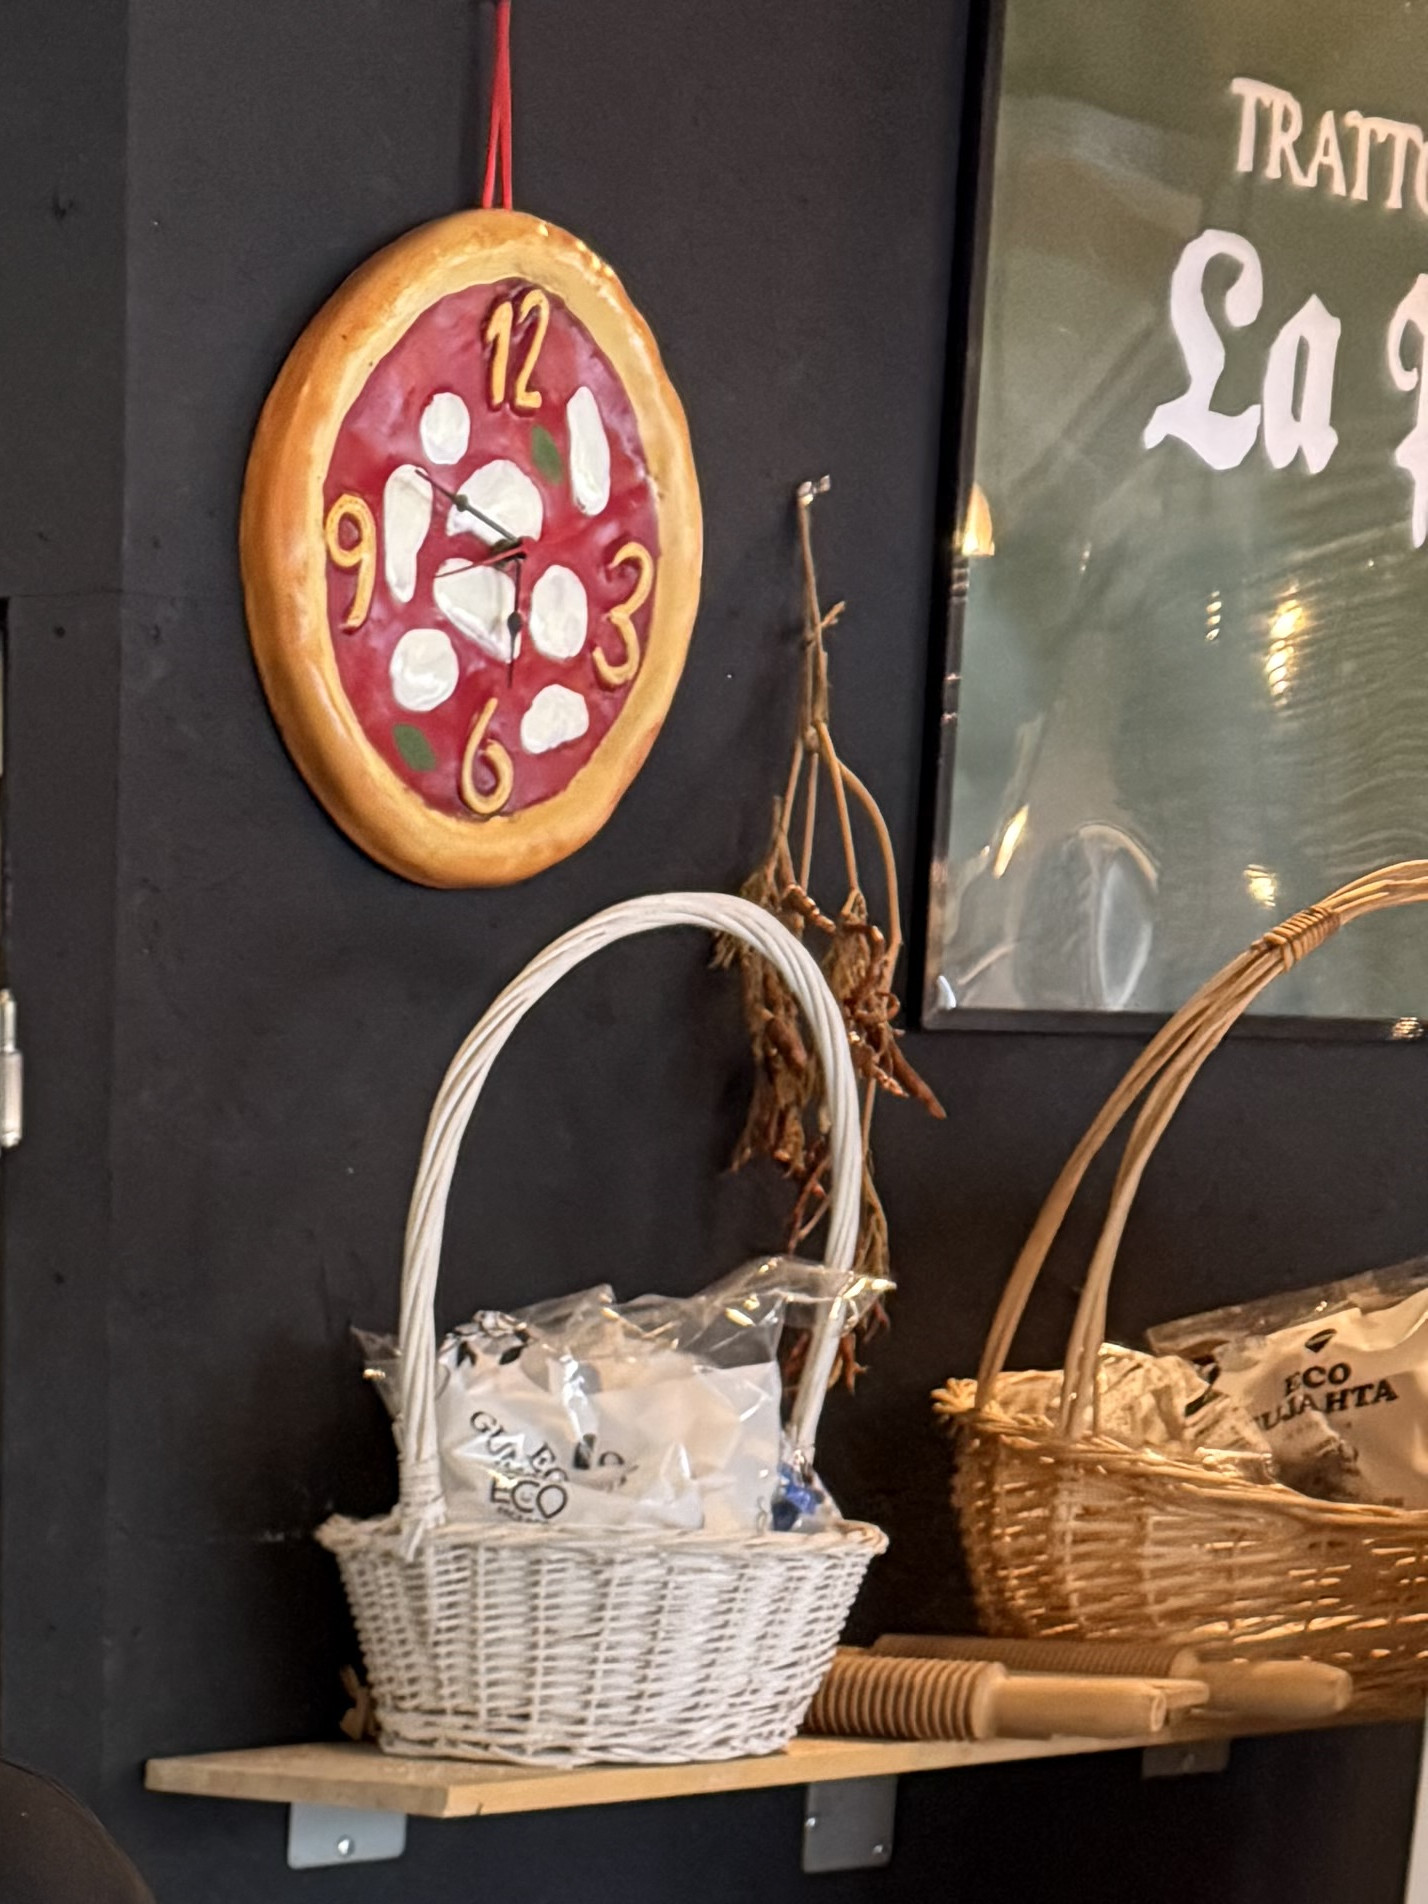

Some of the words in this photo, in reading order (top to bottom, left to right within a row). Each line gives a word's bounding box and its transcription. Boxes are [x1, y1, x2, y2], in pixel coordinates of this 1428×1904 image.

[485, 288, 552, 410] 12
[324, 492, 377, 632] 9
[593, 542, 655, 688] 3
[460, 697, 514, 816] 6
[1253, 1379, 1400, 1431] UJAHTA
[1285, 1363, 1352, 1396] ECO
